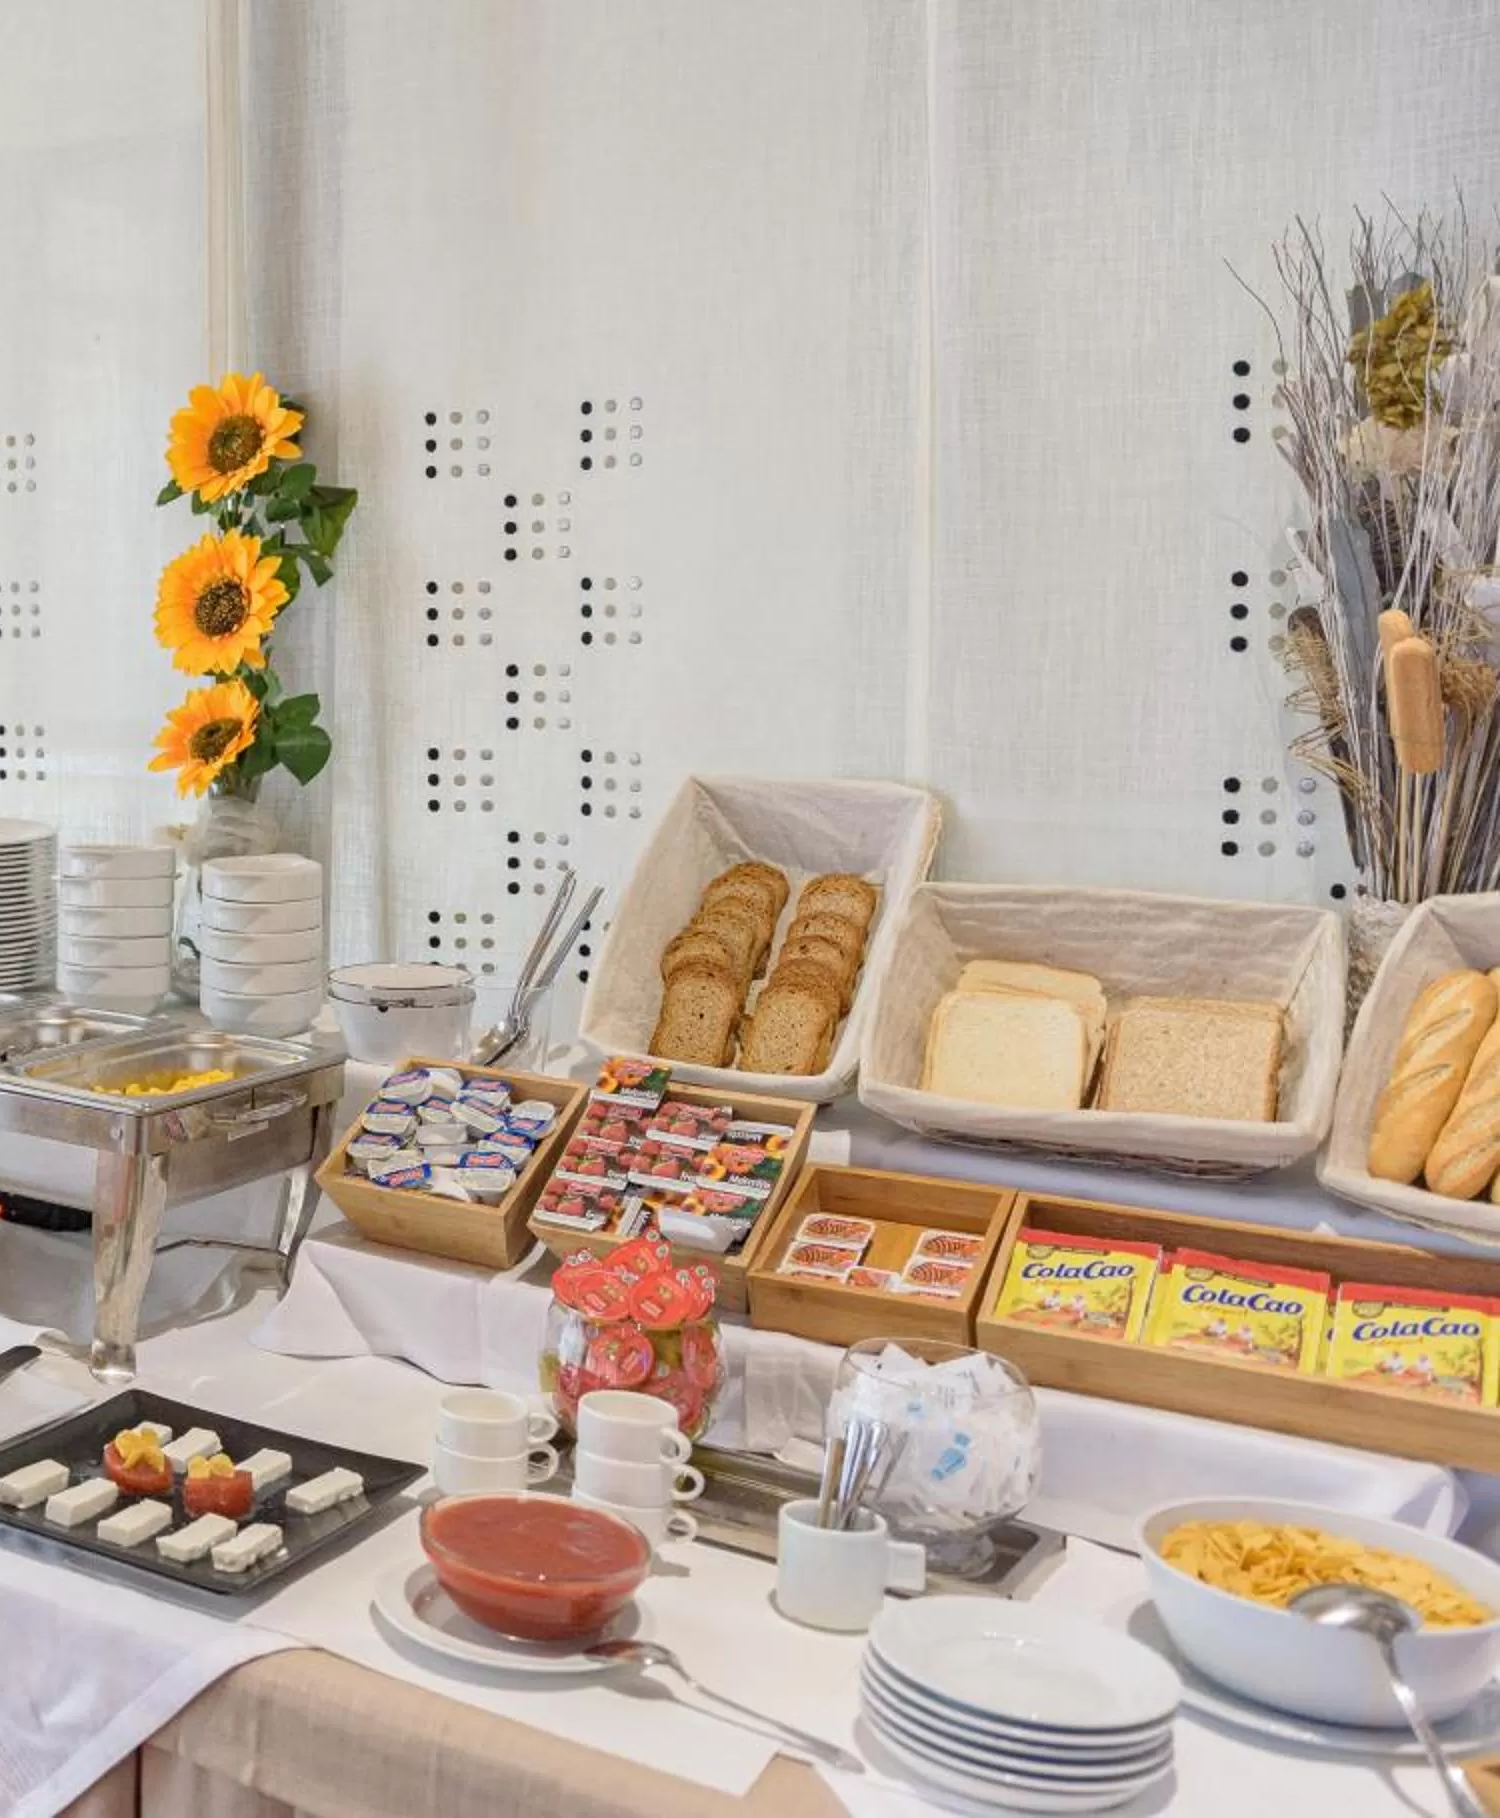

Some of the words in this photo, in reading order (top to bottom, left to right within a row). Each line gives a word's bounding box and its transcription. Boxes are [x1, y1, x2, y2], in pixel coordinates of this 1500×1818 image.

[1022, 1260, 1135, 1280] ColaCao
[1182, 1283, 1304, 1315] ColaCao
[1352, 1316, 1481, 1342] ColaCao
